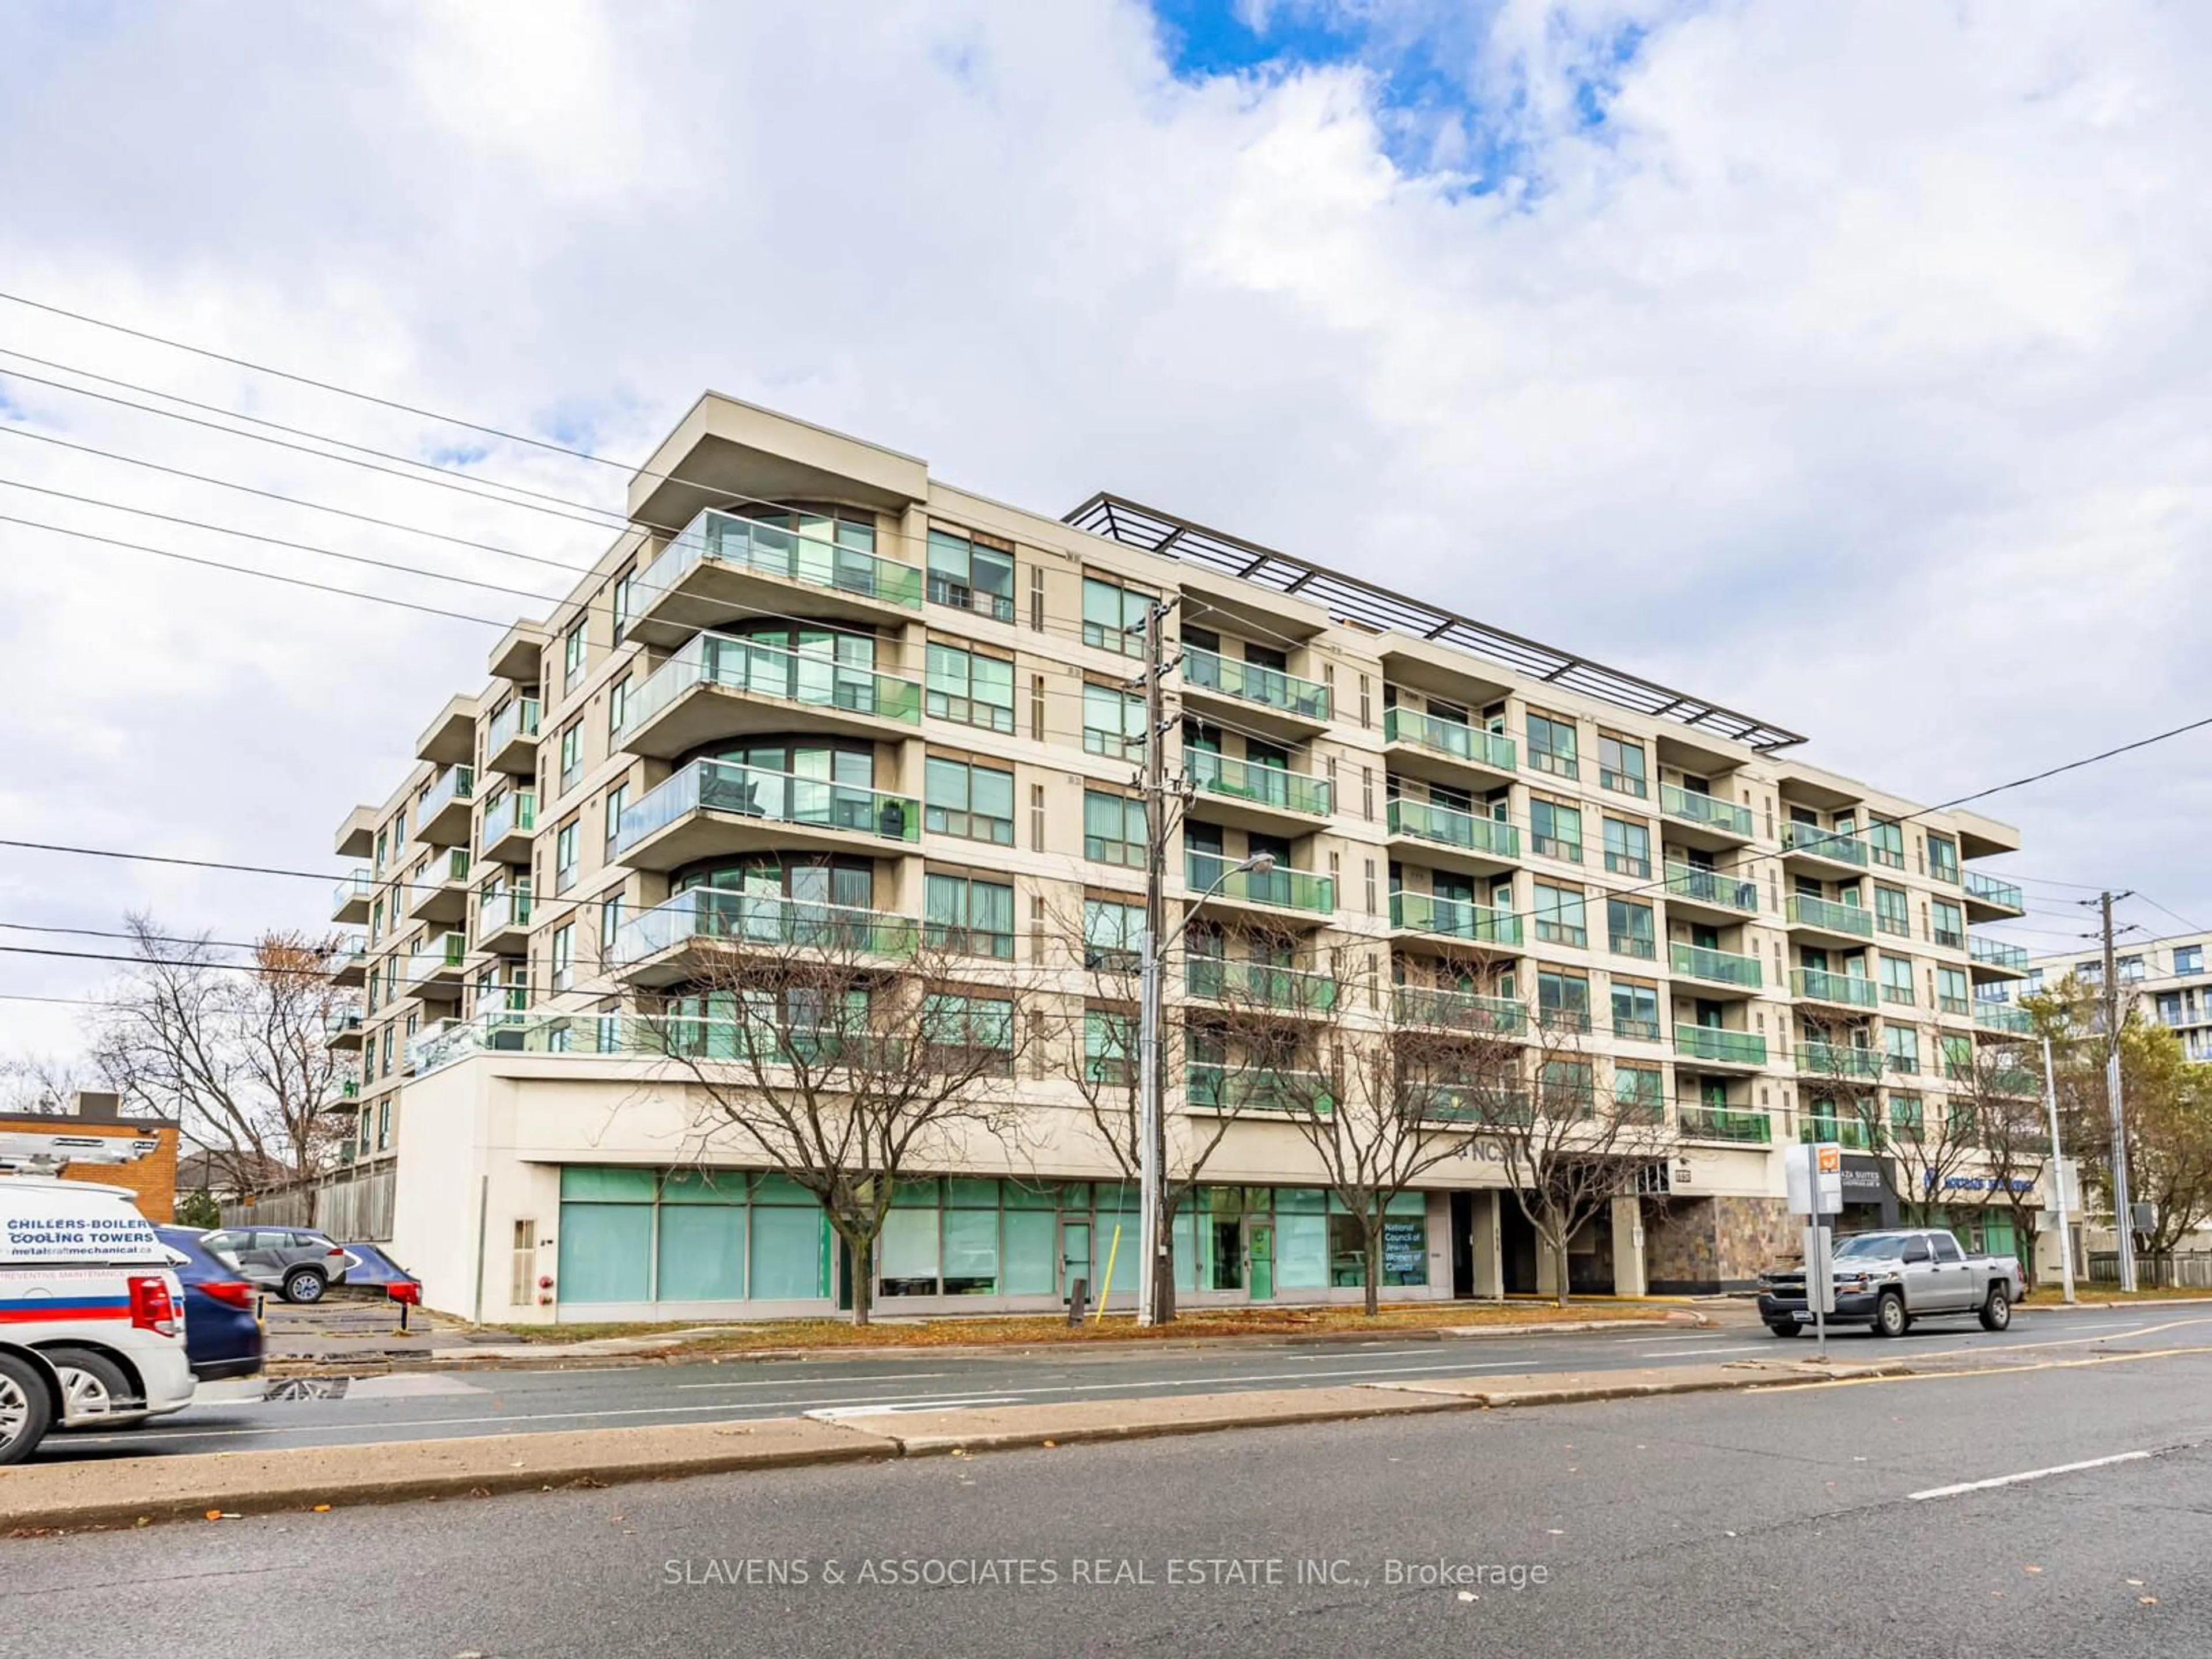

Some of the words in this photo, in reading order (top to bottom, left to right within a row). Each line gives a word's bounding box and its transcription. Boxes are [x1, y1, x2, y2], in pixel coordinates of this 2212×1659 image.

[1855, 1171, 1879, 1179] SUITES
[9, 1232, 84, 1244] COOLING
[89, 1233, 154, 1243] TOWERS
